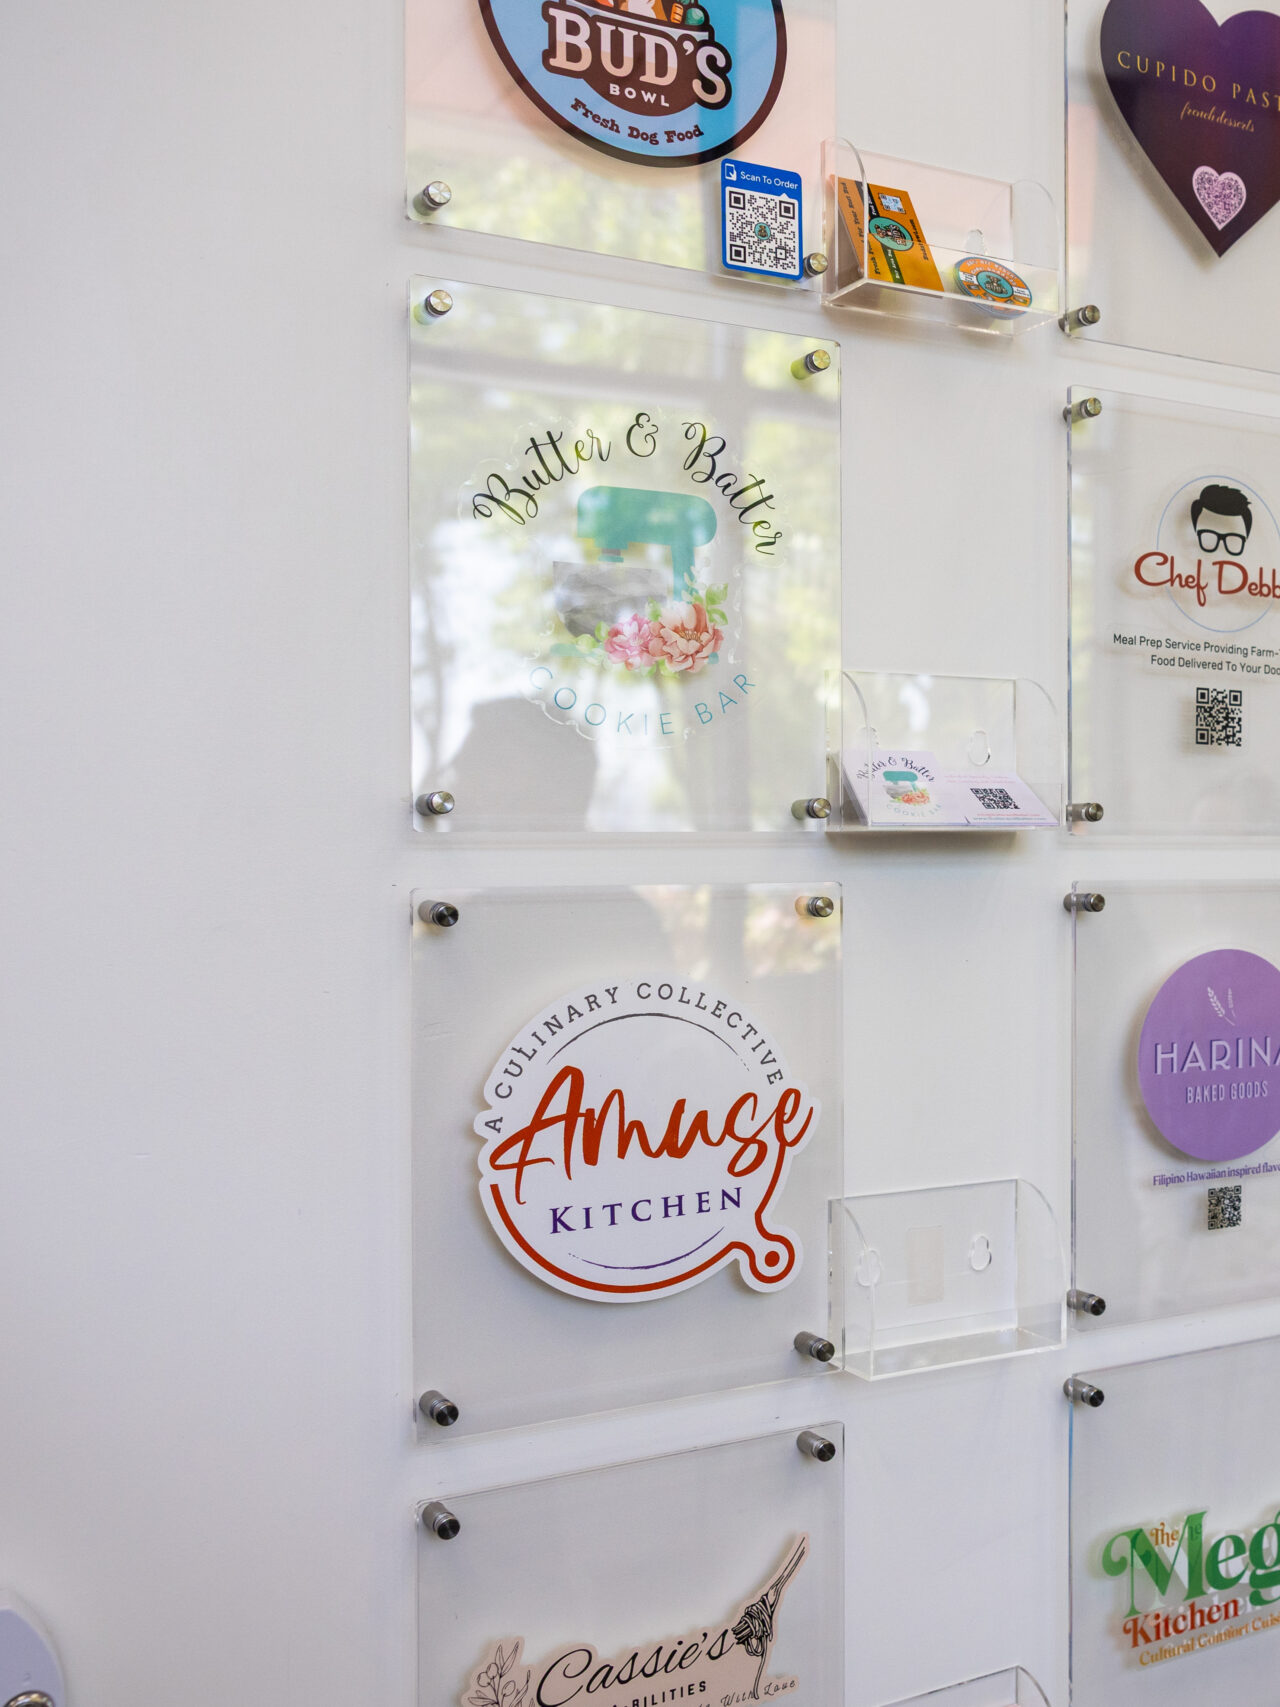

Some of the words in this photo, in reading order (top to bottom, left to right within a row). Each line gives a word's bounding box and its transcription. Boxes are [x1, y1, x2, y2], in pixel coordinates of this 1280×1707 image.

[549, 7, 727, 104] BUD'S
[1117, 50, 1217, 93] CUPIDO
[608, 83, 670, 107] BOWL
[570, 97, 621, 134] Fresh
[627, 125, 659, 146] Dog
[665, 124, 705, 144] Food
[740, 170, 761, 183] Scan
[762, 175, 773, 185] To
[773, 177, 799, 190] Order
[472, 428, 612, 526] Butter
[625, 412, 659, 458] &
[681, 421, 783, 556] Batter
[1134, 551, 1209, 607] Chef
[1113, 633, 1137, 646] Meal
[1139, 635, 1163, 649] Prep
[1165, 638, 1201, 651] Service
[1203, 641, 1249, 658] Providing
[1150, 654, 1176, 667] Food
[1178, 656, 1223, 671] Delivered
[1226, 660, 1238, 672] To
[1239, 662, 1261, 674] Your
[528, 666, 675, 736] COOKIE
[694, 673, 756, 725] BAR
[484, 1117, 504, 1133] A
[494, 986, 620, 1100] CULINARY
[636, 982, 784, 1086] COLLECTIVE
[1185, 1083, 1226, 1104] BAKED
[1230, 1080, 1269, 1101] GOODS
[489, 1065, 814, 1205] Amuse
[1152, 1173, 1186, 1187] Filipino
[1186, 1167, 1227, 1182] Hawaiian
[1227, 1163, 1261, 1179] inspired
[549, 1186, 743, 1235] KITCHEN
[1149, 1521, 1180, 1548] The
[1122, 1597, 1240, 1649] Kitchen
[1138, 1637, 1195, 1667] Cultural
[1197, 1622, 1250, 1649] Comfort
[536, 1628, 736, 1707] Cassie's
[612, 1680, 707, 1707] -BILITIES
